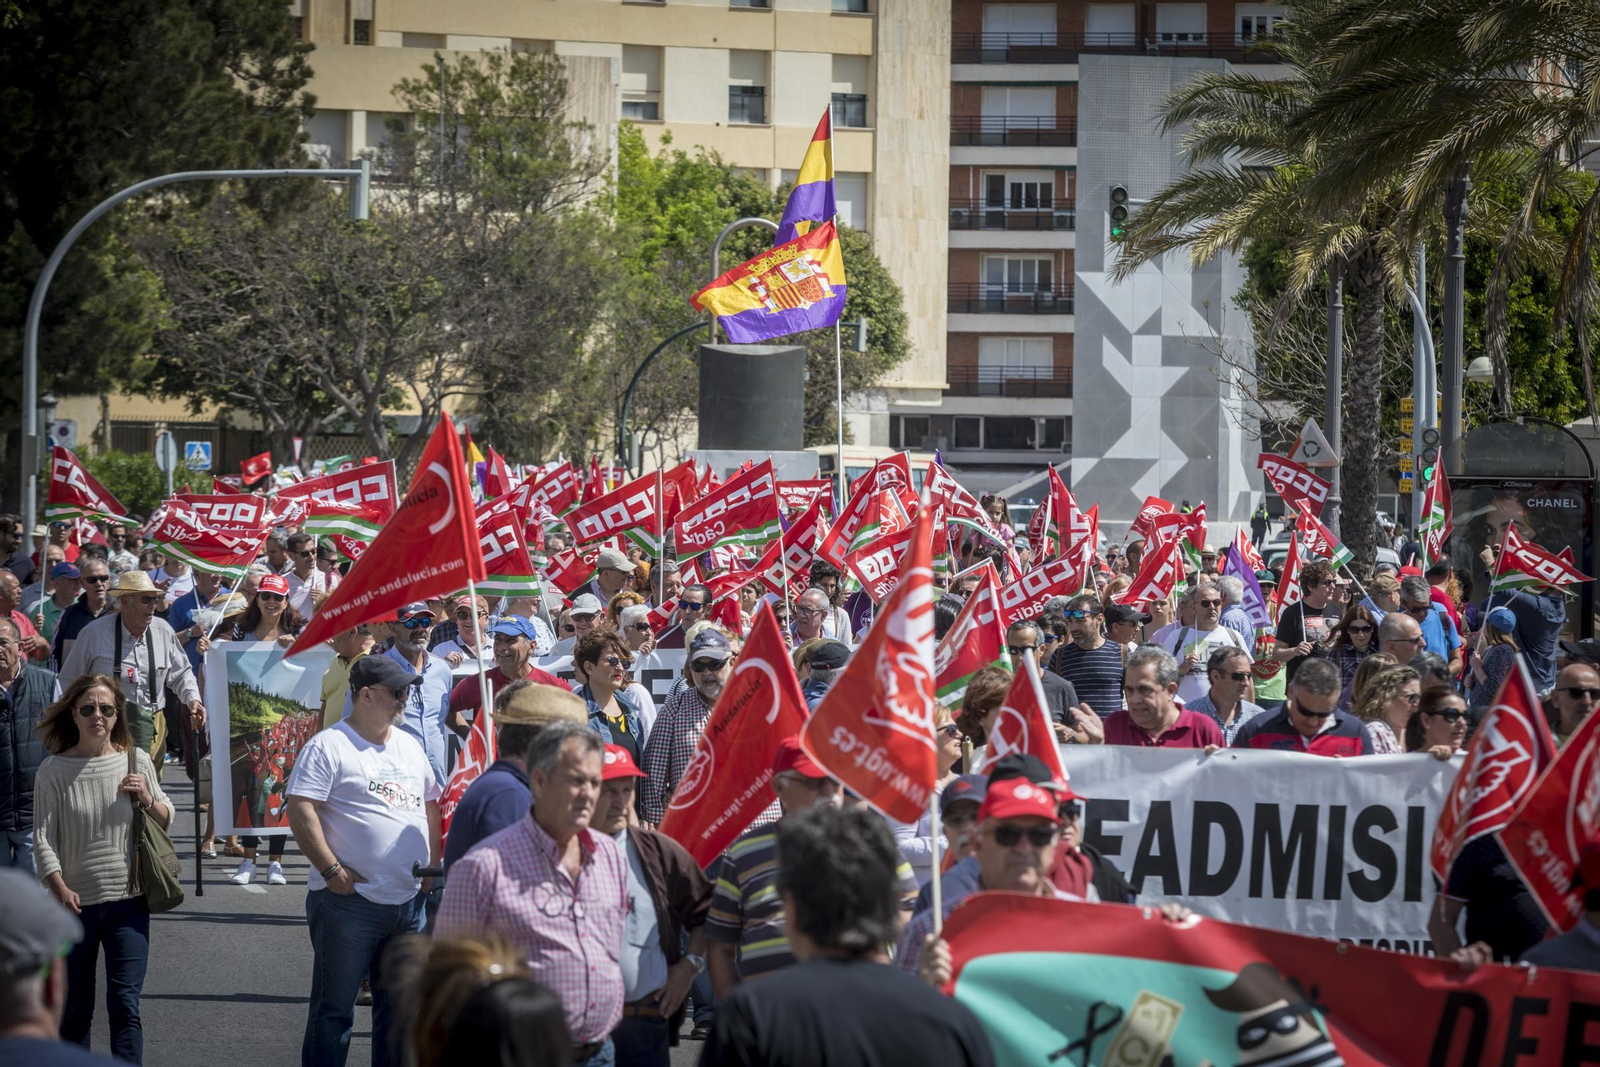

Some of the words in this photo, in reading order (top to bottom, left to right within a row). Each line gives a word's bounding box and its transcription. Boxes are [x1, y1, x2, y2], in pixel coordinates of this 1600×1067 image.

[1526, 498, 1578, 508] CHANEL
[321, 557, 465, 621] www.ugt-andalucia.com
[702, 767, 775, 841] www.ugt-andal
[1083, 798, 1426, 902] EADMISI
